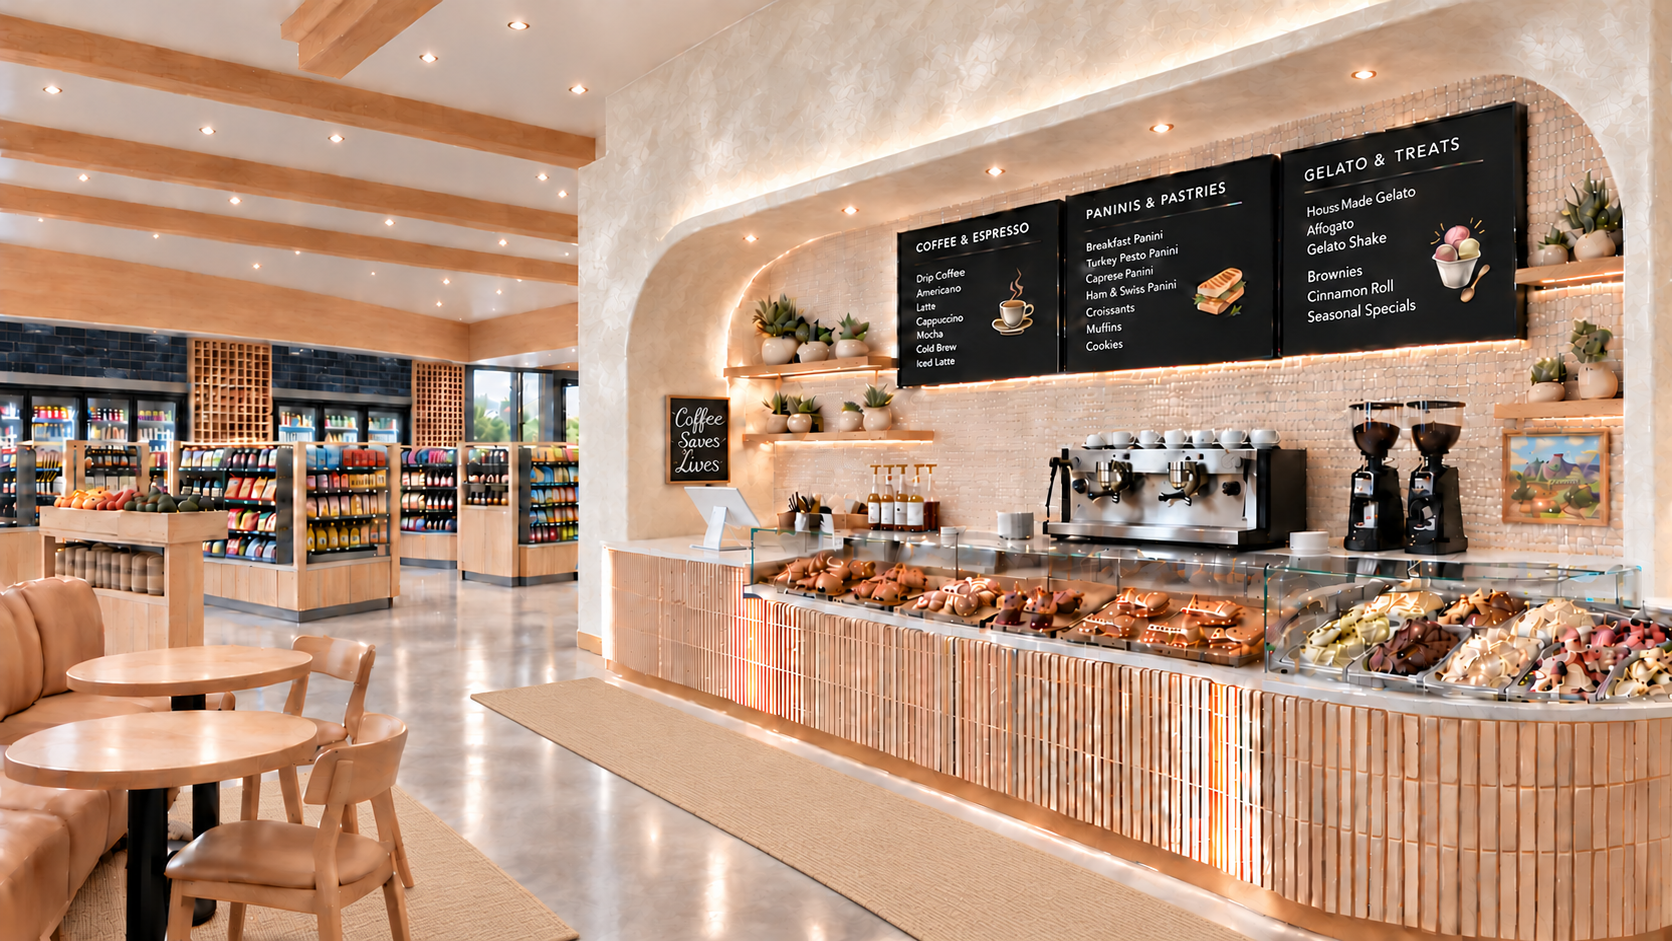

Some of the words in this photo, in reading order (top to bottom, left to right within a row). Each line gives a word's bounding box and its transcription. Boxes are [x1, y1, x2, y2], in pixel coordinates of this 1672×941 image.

[1304, 157, 1368, 182] GELATO
[1373, 153, 1386, 168] &
[1394, 137, 1461, 163] TREATS
[1086, 200, 1141, 220] PANINIS
[1145, 197, 1155, 209] &
[1161, 182, 1226, 205] PASTRIES
[1341, 196, 1373, 211] Made
[1375, 186, 1417, 203] Gelato
[1306, 219, 1355, 236] Affogato
[915, 236, 957, 253] COFFEE
[960, 235, 969, 245] &
[972, 222, 1030, 243] ESPRESSO
[1086, 237, 1132, 252] Breakfast
[1134, 230, 1164, 245] Panini
[1306, 240, 1346, 256] Gelato
[1349, 232, 1387, 249] Shake
[1086, 254, 1118, 268] Turkey
[1119, 251, 1147, 262] Pesto
[1149, 244, 1179, 258] Panini
[916, 274, 934, 283] Drip
[935, 268, 966, 280] Coffee
[1085, 271, 1124, 284] Caprese
[1125, 266, 1154, 278] Panini
[1307, 266, 1363, 283] Brownies
[916, 285, 962, 298] Americano
[1086, 291, 1108, 301] Ham
[1109, 287, 1118, 297] &
[1119, 285, 1145, 296] Swiss
[1148, 279, 1178, 292] Panini
[1307, 286, 1368, 303] Cinnamon
[1371, 279, 1394, 294] Roll
[916, 303, 936, 313] Latte
[1085, 304, 1135, 317] Croissants
[1307, 305, 1362, 323] Seasonal
[1365, 298, 1417, 318] Specials
[916, 314, 964, 327] Cappuccino
[1086, 322, 1123, 334] Muffins
[916, 330, 944, 340] Mocha
[916, 344, 934, 354] Cold
[936, 343, 957, 352] Brew
[1085, 340, 1124, 352] Cookies
[916, 359, 933, 368] Iced
[935, 357, 956, 366] Latte
[675, 406, 725, 434] Coffee
[678, 431, 721, 448] Saves
[675, 449, 720, 473] Lives
